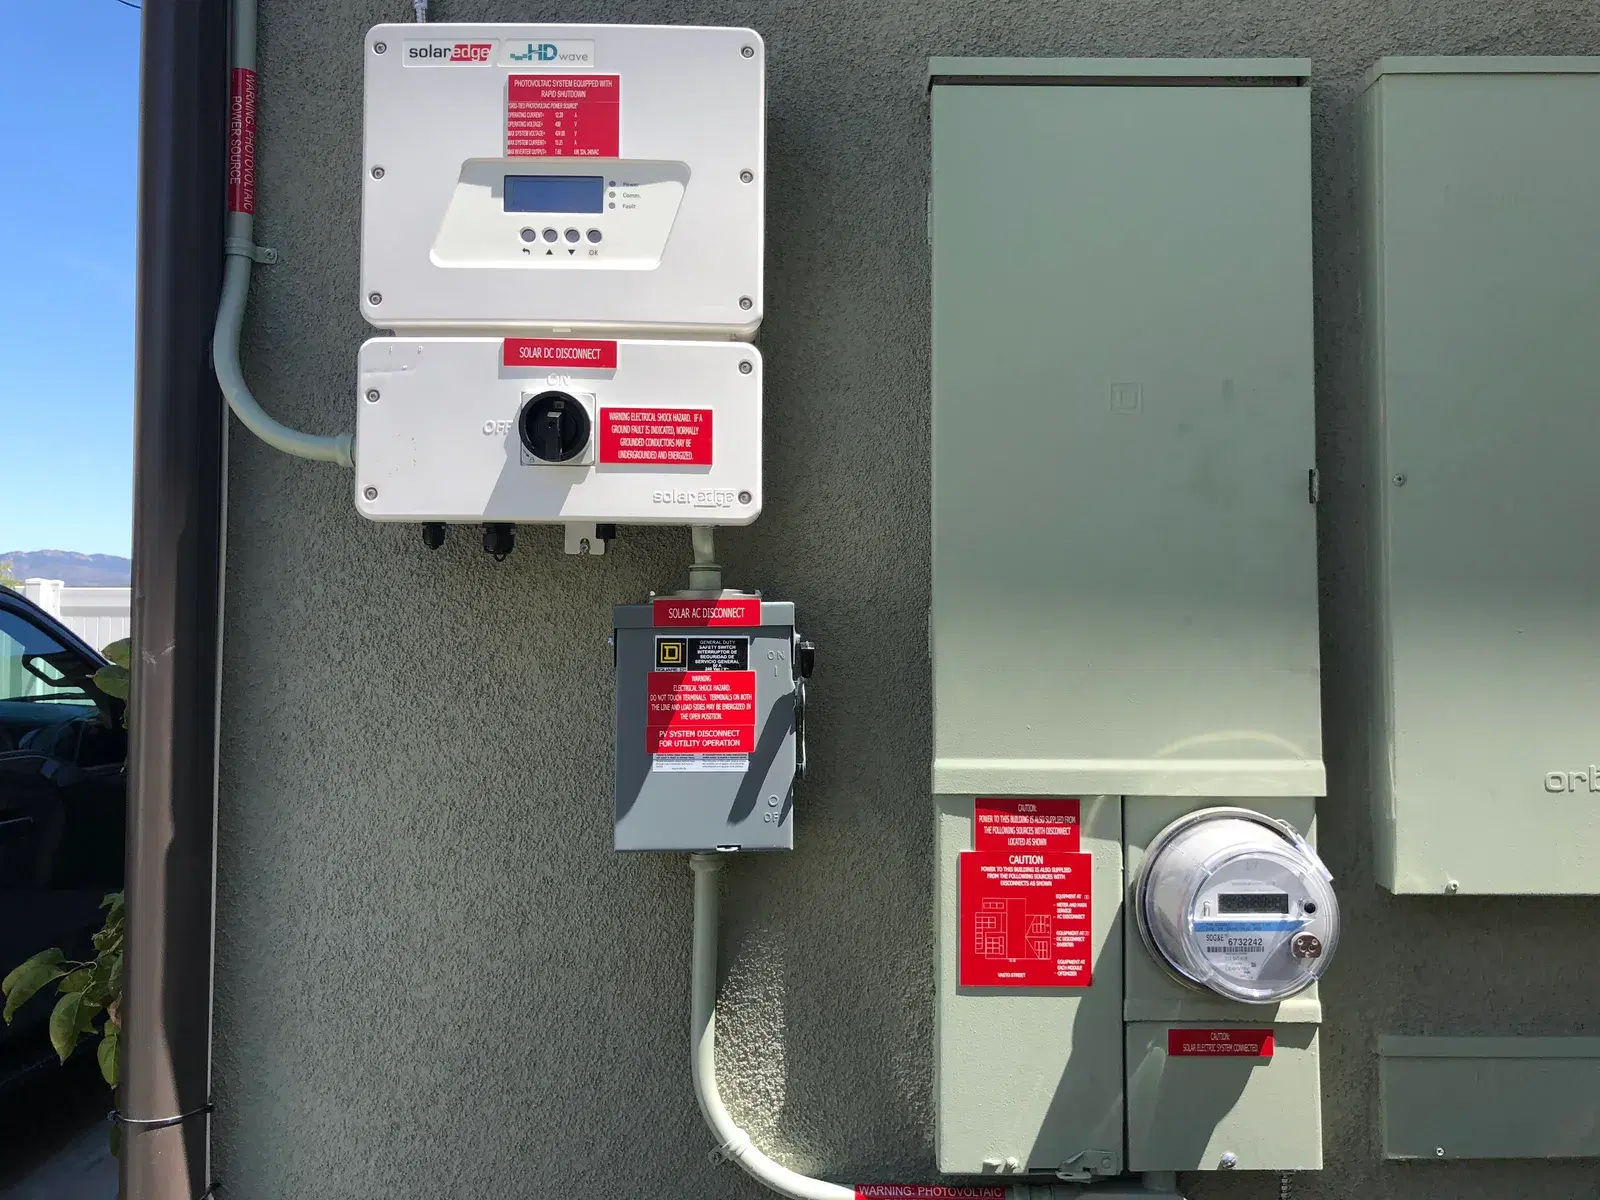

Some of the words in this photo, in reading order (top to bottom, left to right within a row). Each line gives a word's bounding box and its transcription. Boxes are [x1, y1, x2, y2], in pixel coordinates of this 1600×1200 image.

[409, 44, 490, 62] solaredge
[527, 44, 557, 61] HD
[558, 53, 588, 61] wave
[514, 79, 551, 87] PHOTOVOLTAIC
[552, 79, 573, 87] SYSTEM
[573, 79, 598, 87] EQUIPPED
[599, 79, 613, 87] WITH
[541, 90, 556, 98] RAPID
[557, 90, 586, 98] SHUTDOWN
[245, 74, 255, 127] WARNING:
[231, 96, 242, 136] POWER
[230, 139, 241, 184] SOURCE
[244, 129, 254, 210] PHOTOVOLTAIC
[520, 347, 542, 359] SOLAR
[543, 347, 554, 359] DC
[556, 347, 601, 360] DISCONNECT
[609, 412, 630, 421] WARNING
[631, 412, 656, 421] ELECTRICAL
[657, 413, 672, 421] SHOCK
[483, 419, 511, 436] OFF
[611, 425, 630, 434] GROUND
[631, 425, 644, 434] FAULT
[676, 426, 699, 435] NORMALLY
[619, 438, 644, 447] GROUNDED
[645, 438, 675, 447] CONDUCTORS
[675, 438, 685, 447] MAY
[685, 439, 692, 448] BE
[618, 450, 657, 459] UNDERGROUNDED
[657, 451, 667, 460] AND
[668, 607, 690, 619] SOLAR
[691, 607, 702, 619] AC
[702, 607, 745, 618] DISCONNECT
[766, 650, 785, 661] ON
[673, 684, 698, 692] ELECTRICAL
[698, 684, 713, 692] SHOCK
[660, 703, 671, 711] LINE
[671, 703, 680, 711] AND
[681, 703, 691, 711] LOAD
[702, 739, 740, 747] OPERATION
[978, 815, 993, 823] POWER
[993, 815, 999, 823] TO
[999, 815, 1010, 823] THIS
[1010, 815, 1029, 823] BUILDING
[1034, 815, 1045, 824] ALSO
[1045, 816, 1064, 824] SUPPLIED
[1064, 816, 1076, 824] FROM
[983, 826, 992, 834] THE
[992, 826, 1015, 835] FOLLOWING
[1016, 826, 1034, 835] SOURCES
[1035, 826, 1045, 835] WITH
[1046, 827, 1071, 835] DISCONNECT
[1008, 838, 1025, 846] LOCATED
[1025, 838, 1031, 846] AS
[1031, 838, 1047, 846] SHOWN
[1009, 855, 1044, 864] CAUTION
[1228, 938, 1263, 946] 6732242
[1182, 1044, 1196, 1052] SOLAR
[1196, 1044, 1216, 1052] ELECTRIC
[1216, 1044, 1233, 1052] SYSTEM
[1233, 1044, 1258, 1052] CONNECTED
[860, 1186, 915, 1196] WARNING:
[918, 1187, 1002, 1196] PHOTOVOLTAIC
